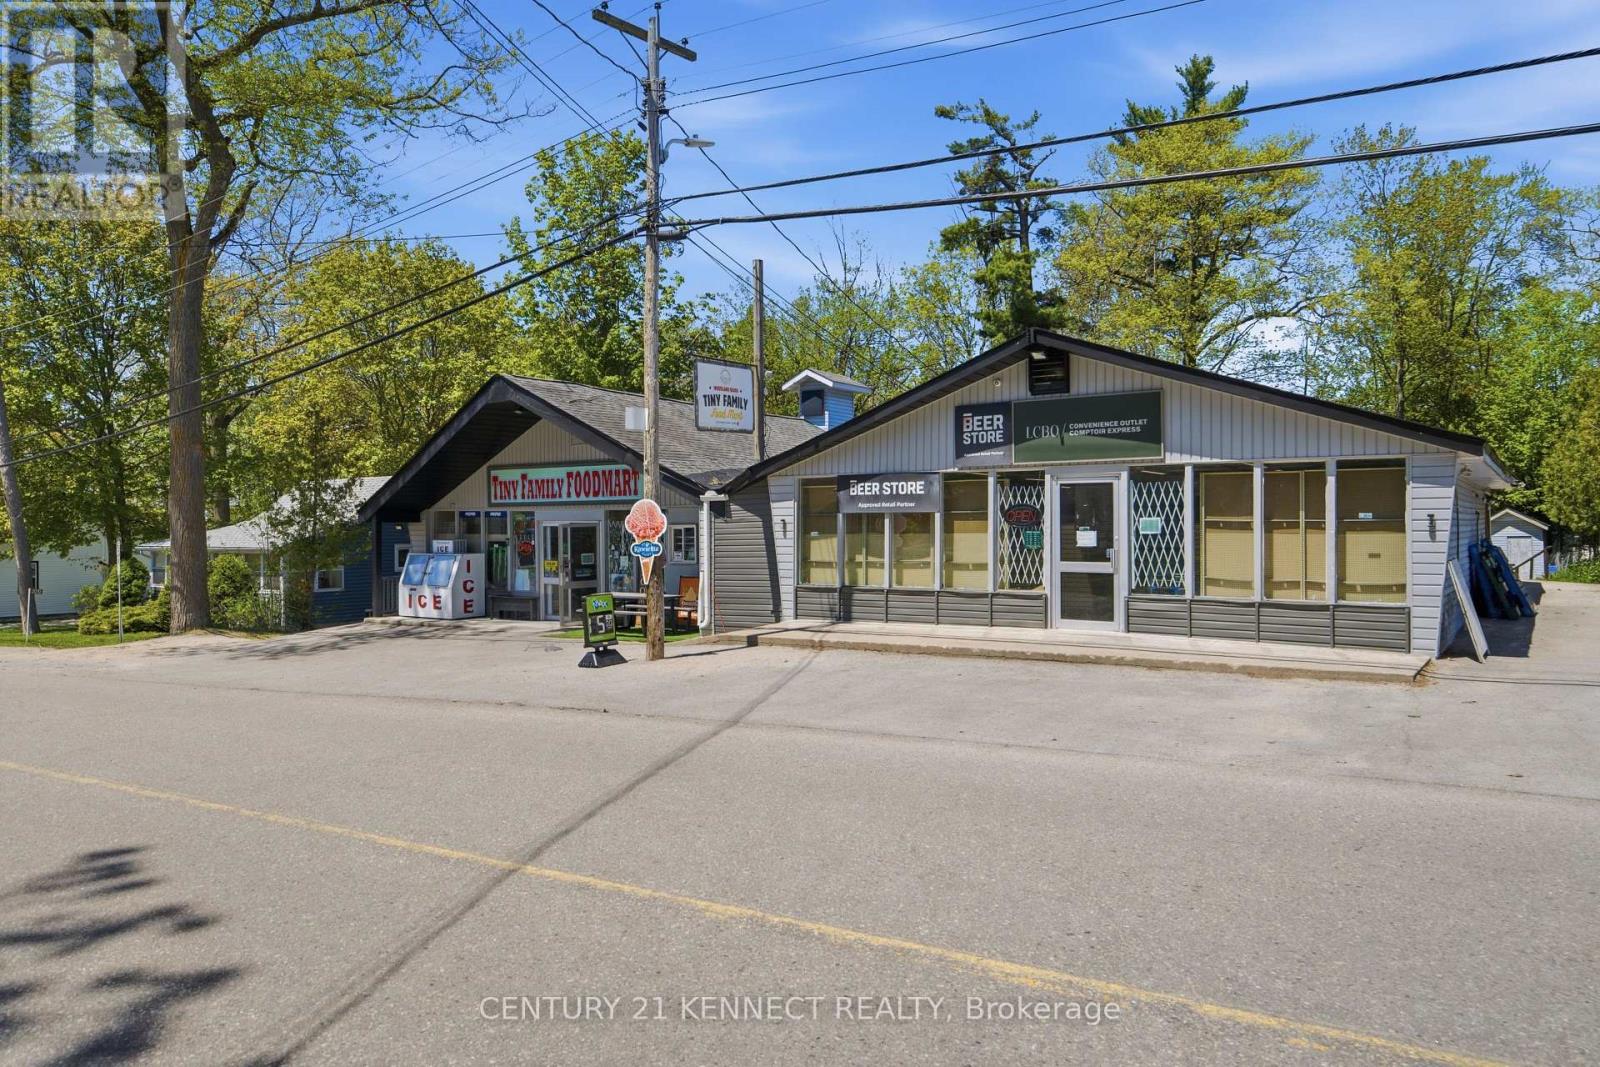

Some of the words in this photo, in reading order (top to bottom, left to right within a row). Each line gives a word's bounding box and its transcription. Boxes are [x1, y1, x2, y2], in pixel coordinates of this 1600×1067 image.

[703, 394, 721, 407] TINY
[723, 395, 748, 410] FAMILY
[963, 413, 1004, 431] BEER
[1069, 420, 1119, 430] CONVENIENCE
[1120, 418, 1148, 426] OUTLET
[963, 430, 1004, 444] STORE
[1026, 424, 1060, 438] LCBO
[1069, 428, 1106, 436] COMPTOIR
[1107, 426, 1141, 434] EXPRESS
[492, 475, 519, 500] TINY
[520, 473, 564, 499] FAMILY
[566, 467, 640, 498] FOODMART
[850, 480, 880, 496] BEER
[882, 481, 925, 495] STORE
[1007, 510, 1036, 521] OPEN
[437, 545, 449, 553] ICE
[408, 593, 442, 610] ICE
